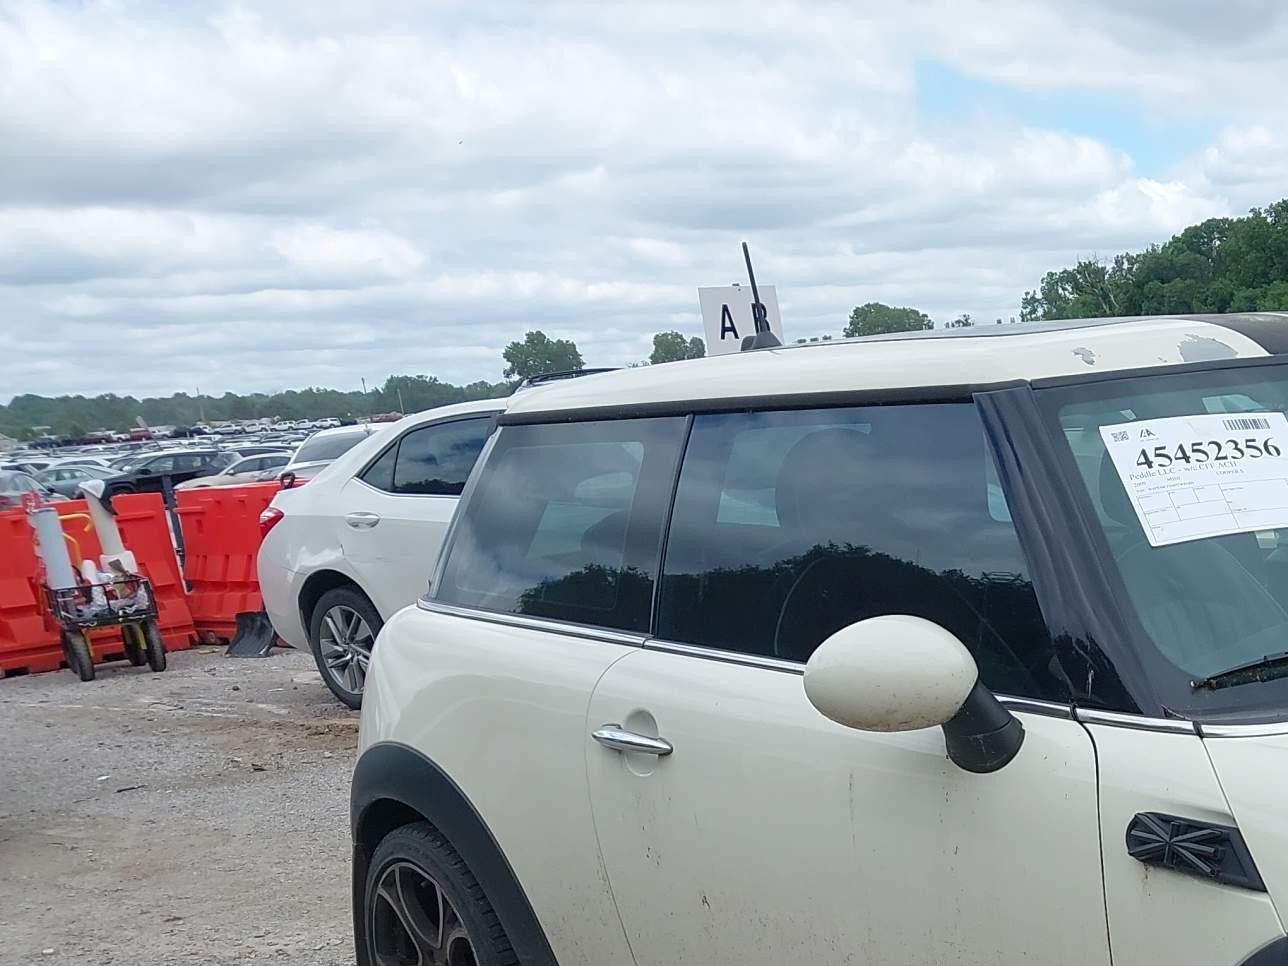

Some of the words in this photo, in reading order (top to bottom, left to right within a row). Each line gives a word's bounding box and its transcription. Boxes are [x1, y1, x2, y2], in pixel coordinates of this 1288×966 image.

[720, 304, 740, 340] A
[1136, 437, 1281, 470] 45452356
[1129, 471, 1156, 482] Peddle
[1158, 467, 1176, 478] LLC
